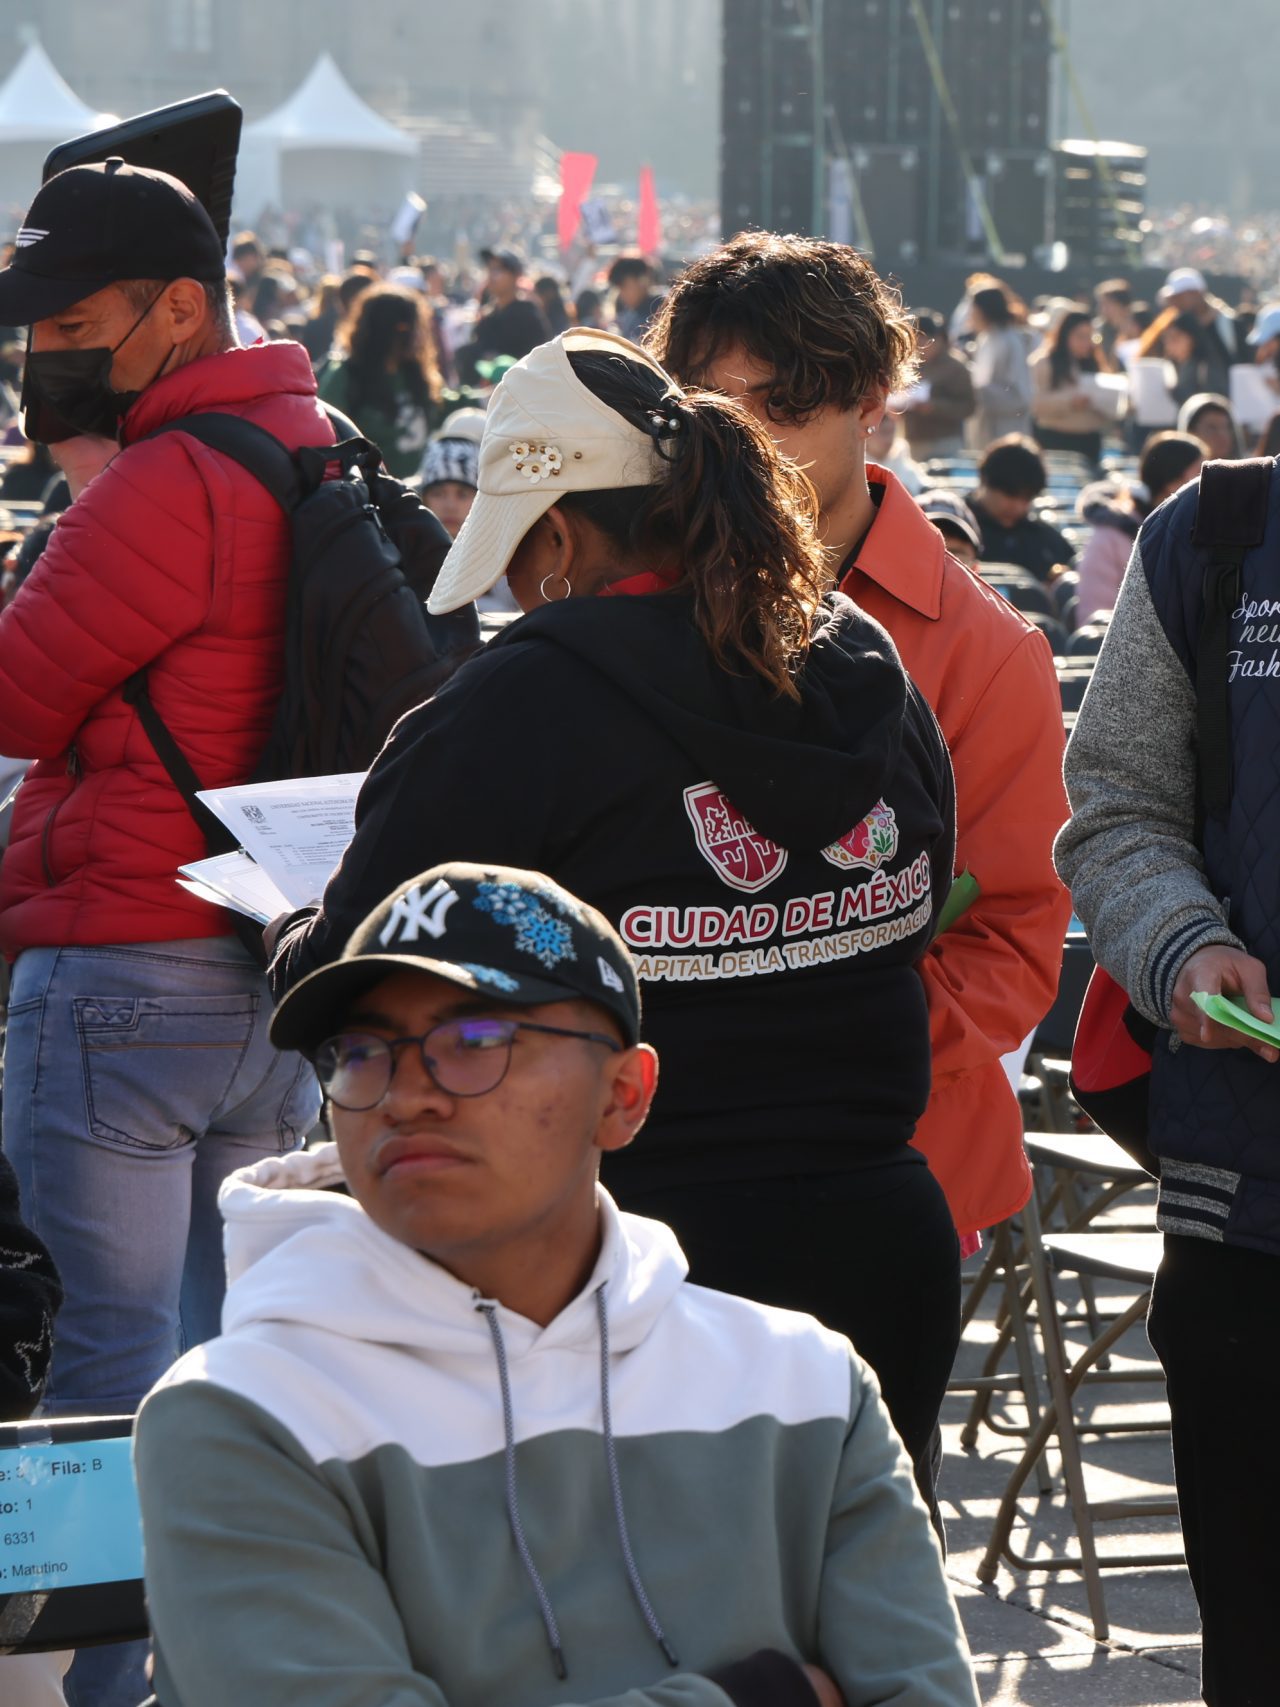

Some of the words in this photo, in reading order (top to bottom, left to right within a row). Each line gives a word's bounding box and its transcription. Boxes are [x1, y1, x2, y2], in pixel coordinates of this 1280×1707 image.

[622, 907, 777, 946] CIUDAD
[784, 894, 833, 933] DE
[838, 853, 930, 923] MÉXICO
[380, 879, 460, 948] NY
[634, 955, 717, 979] APITAL
[721, 953, 751, 975] DE
[756, 949, 782, 971] LA
[51, 1460, 86, 1476] Fila:
[92, 1458, 103, 1471] B
[26, 1499, 32, 1510] 1
[4, 1531, 35, 1546] 6331
[12, 1561, 69, 1577] Matutino
